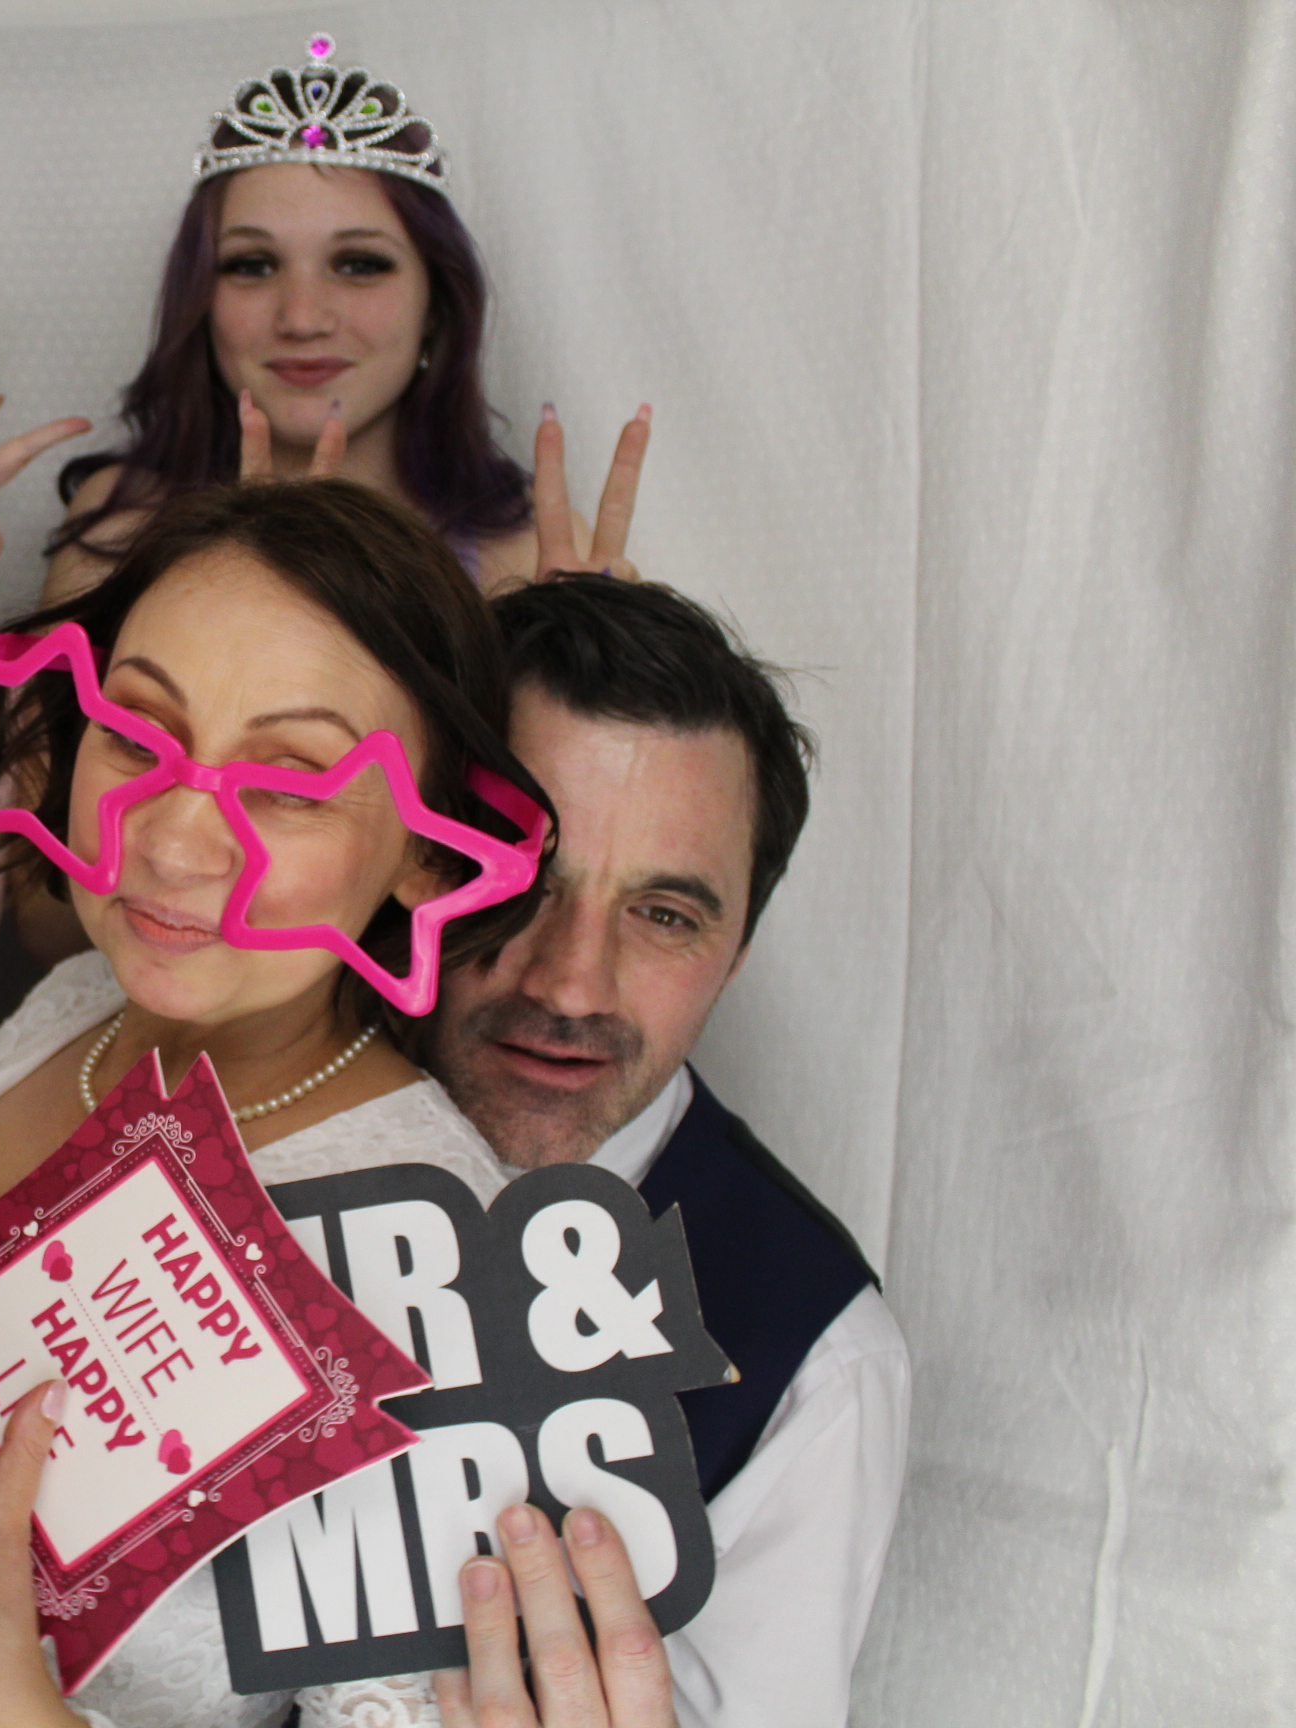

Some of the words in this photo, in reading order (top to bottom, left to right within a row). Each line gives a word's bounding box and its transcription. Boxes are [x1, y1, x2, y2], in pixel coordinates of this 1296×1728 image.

[91, 1258, 194, 1398] WIFE
[141, 1213, 262, 1365] HAPPY
[283, 1200, 483, 1392] R
[521, 1200, 675, 1373] &
[31, 1298, 146, 1452] HAPPY
[245, 1397, 678, 1652] MRS
